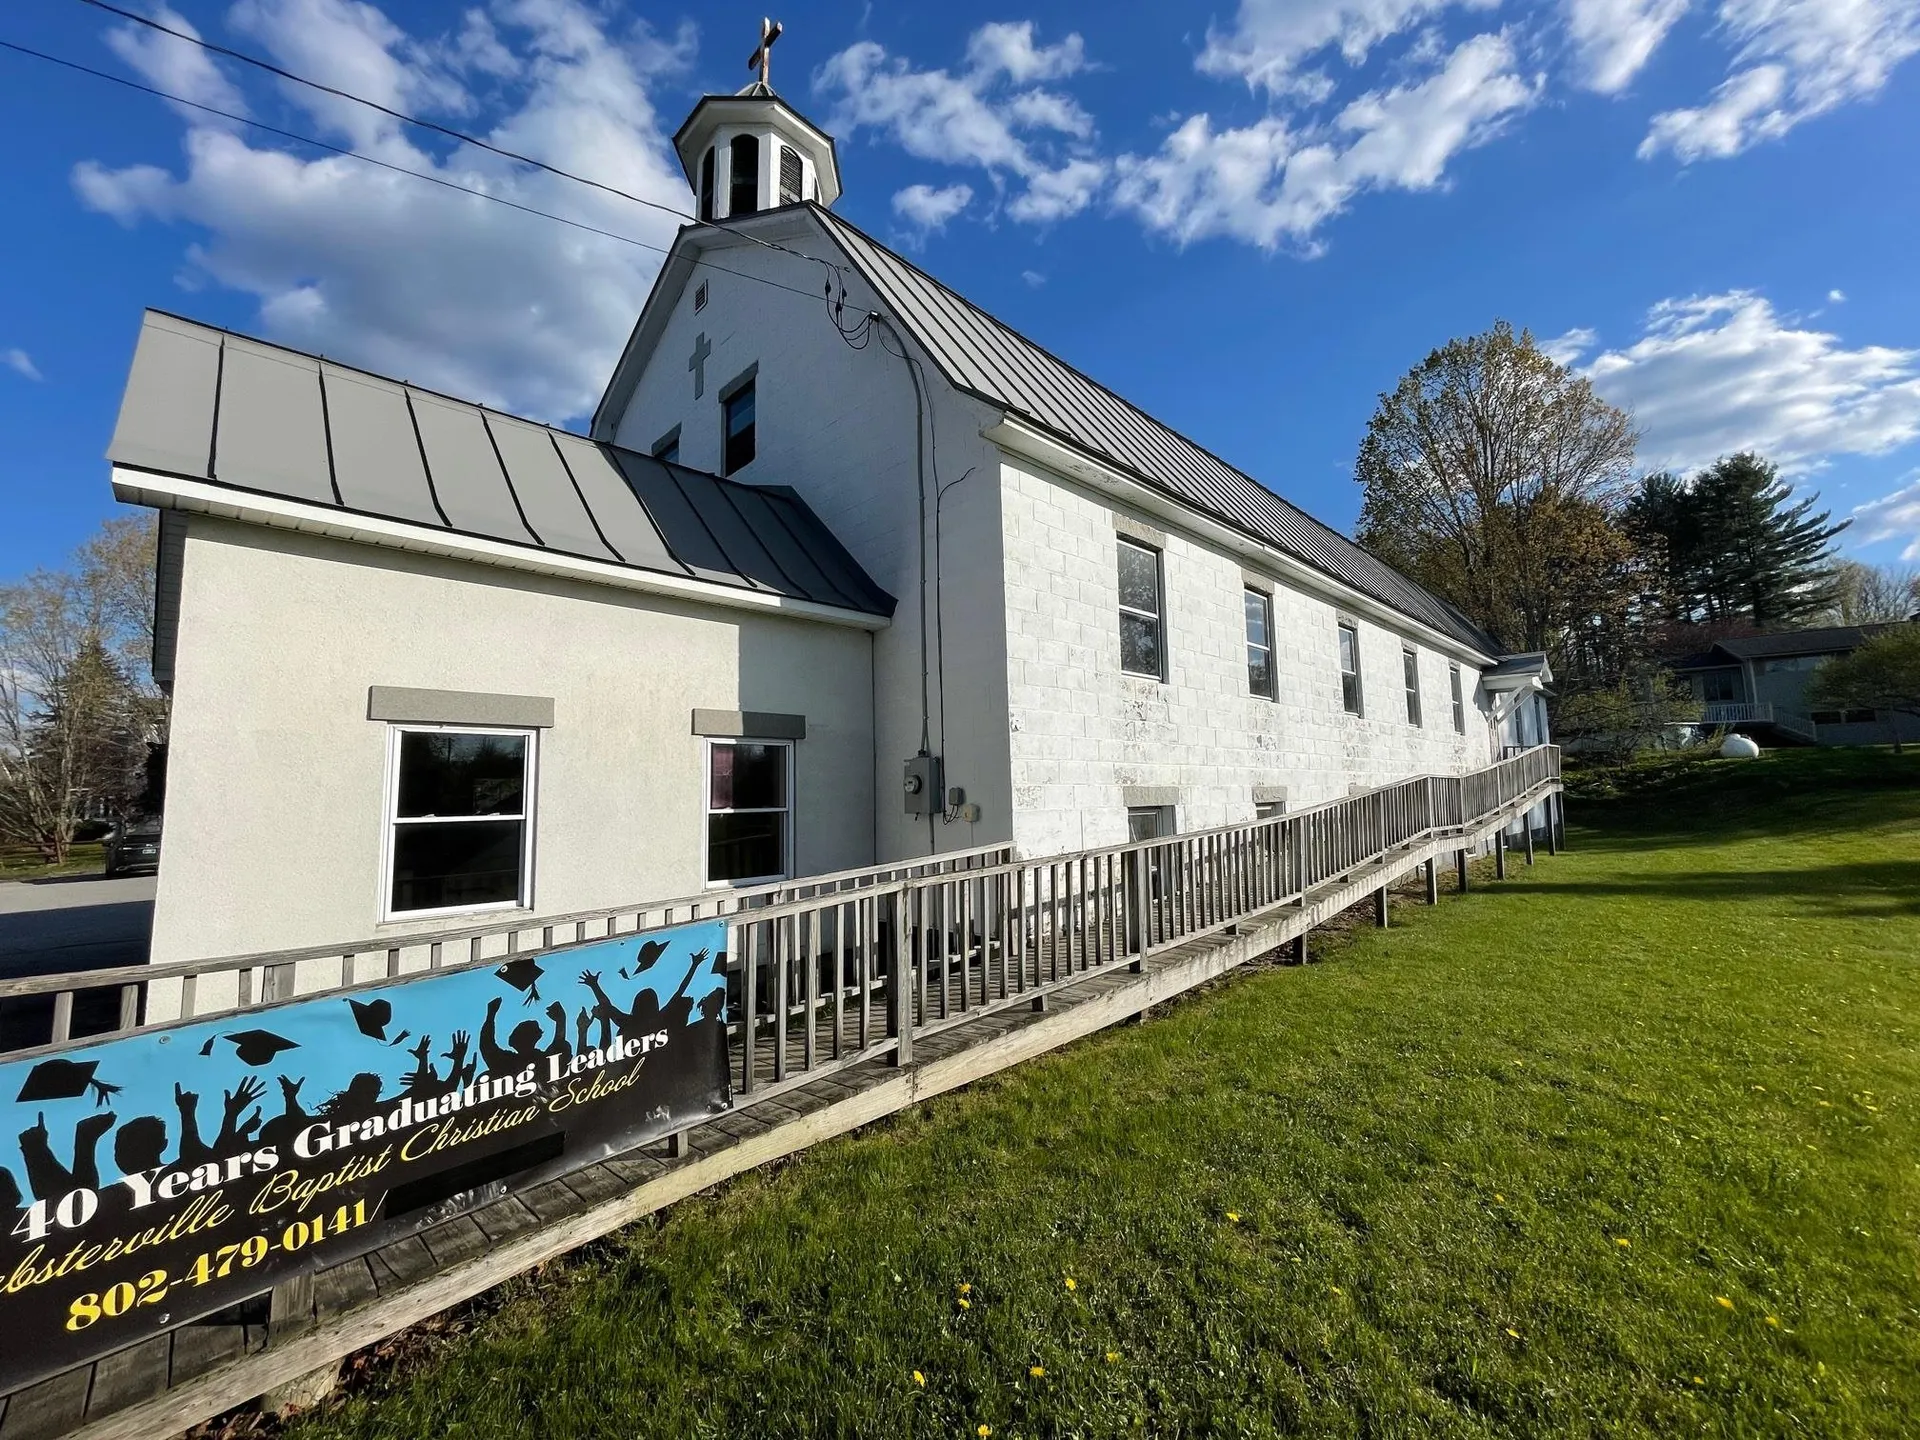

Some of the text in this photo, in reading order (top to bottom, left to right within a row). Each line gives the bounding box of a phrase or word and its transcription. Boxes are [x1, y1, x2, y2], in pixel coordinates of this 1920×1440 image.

[10, 1027, 669, 1243] 40 Years Graduating Leaders
[248, 1143, 394, 1216] Baptist
[400, 1101, 541, 1162] Christian
[548, 1056, 646, 1113] School
